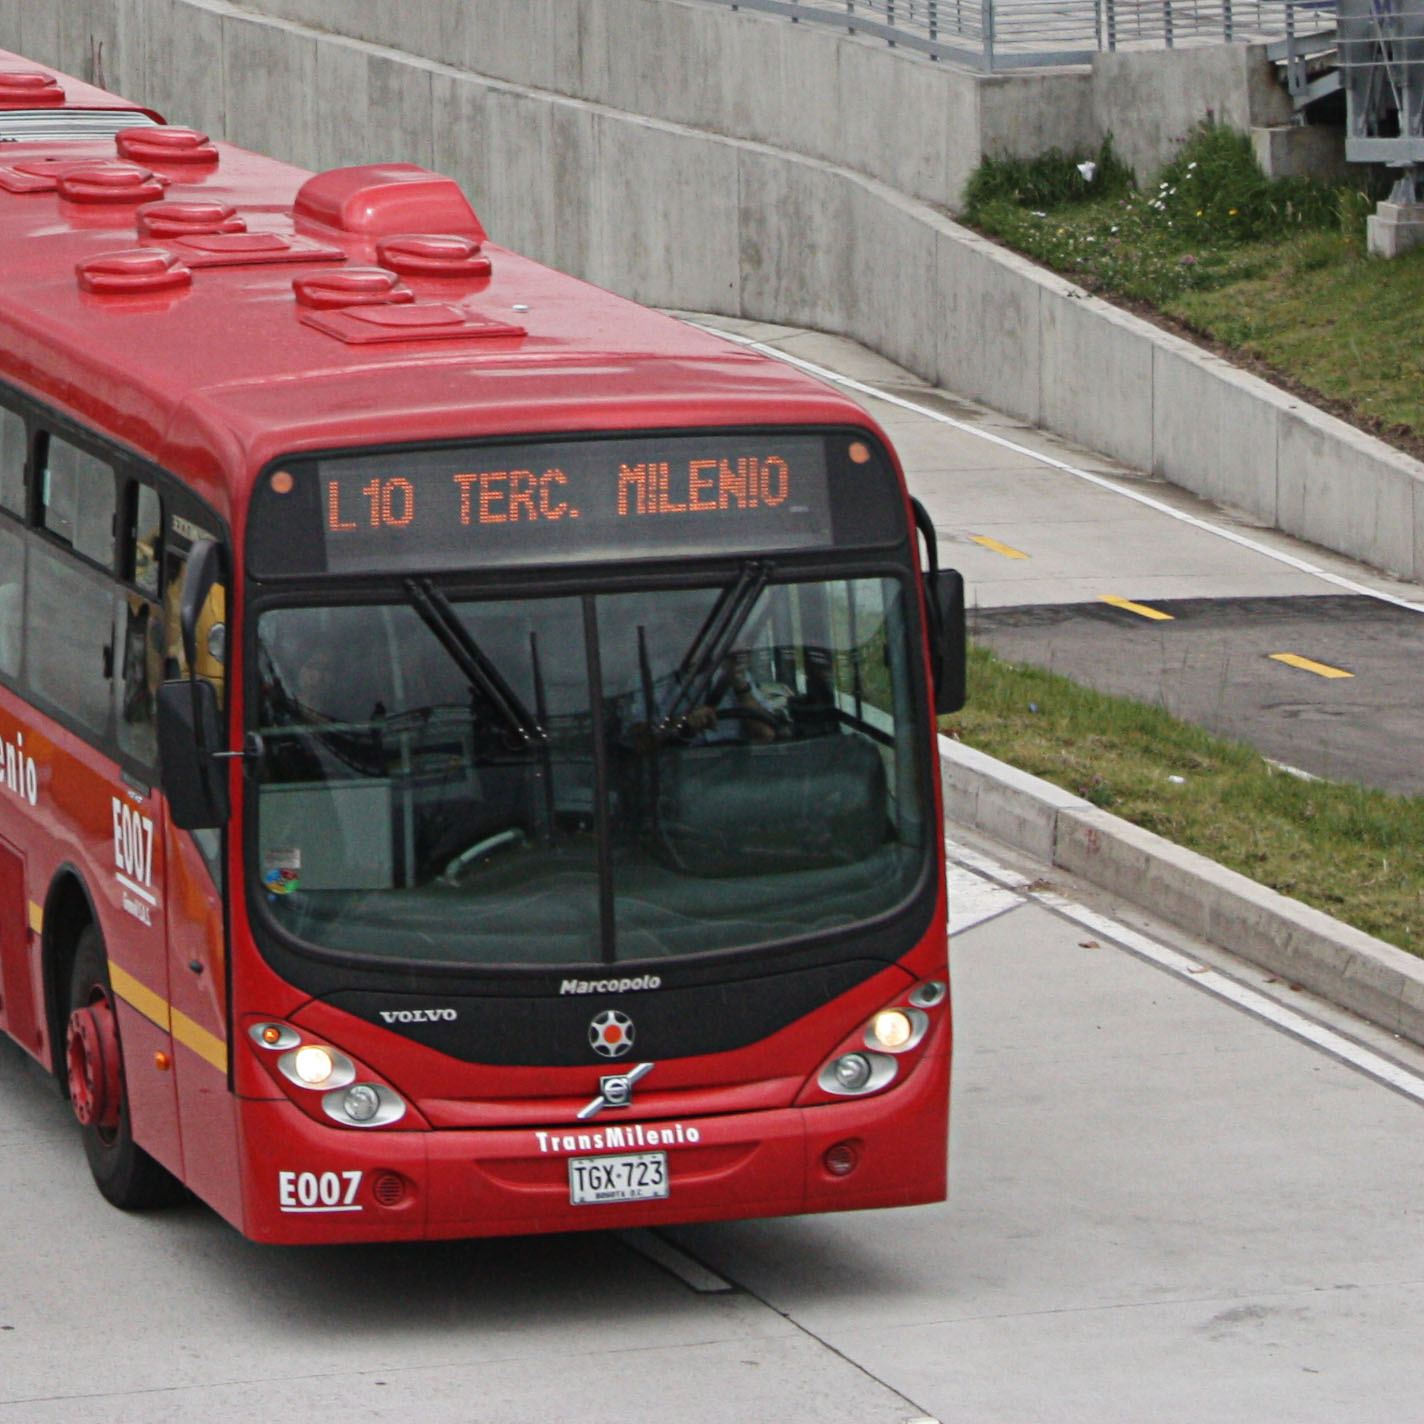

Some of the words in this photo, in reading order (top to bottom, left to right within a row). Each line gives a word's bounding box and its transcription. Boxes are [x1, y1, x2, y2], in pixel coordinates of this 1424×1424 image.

[328, 476, 415, 532] L10
[453, 468, 580, 525] TERC.
[616, 455, 790, 517] MILENIO
[112, 796, 153, 888] E007
[559, 973, 661, 996] Marcopolo
[380, 1007, 458, 1024] VOLVO
[536, 1124, 701, 1155] TransMilenio
[279, 1169, 362, 1208] E007
